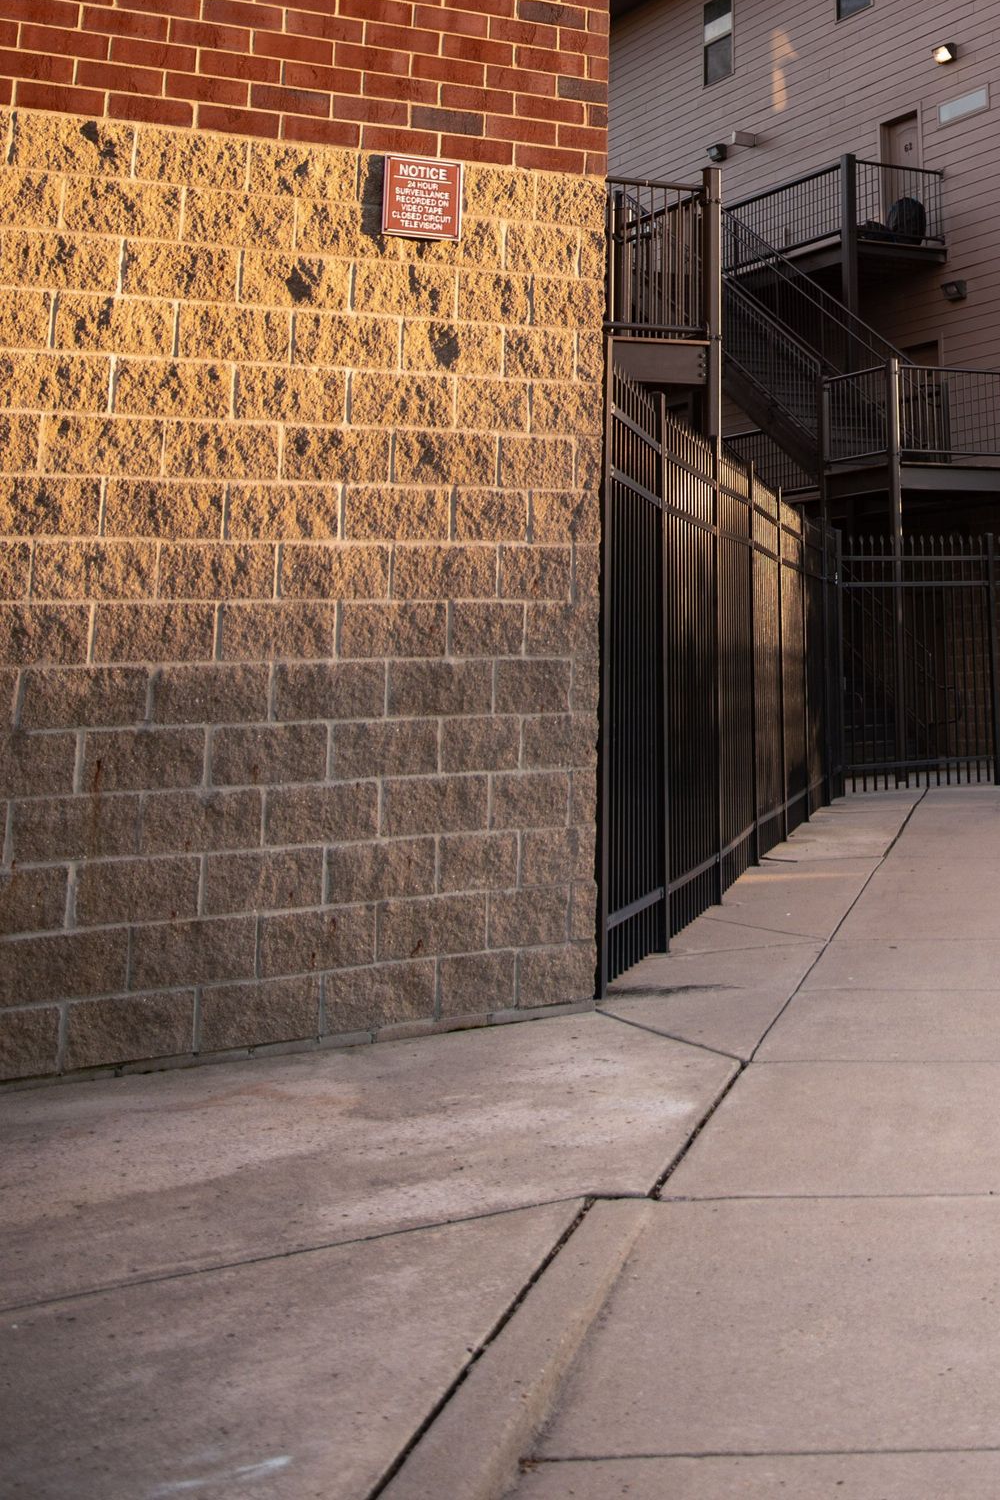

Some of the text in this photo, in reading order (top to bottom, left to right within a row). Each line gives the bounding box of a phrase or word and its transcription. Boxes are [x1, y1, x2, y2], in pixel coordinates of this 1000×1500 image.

[400, 164, 447, 180] NOTICE
[407, 180, 439, 190] 24 HOUR
[395, 186, 450, 200] SURVEILLANCE
[396, 195, 449, 207] RECORDED ON
[401, 204, 443, 215] VIDEO TAPE
[391, 210, 452, 223] CLOSED CIRCUIT
[400, 219, 443, 230] TELEVISION
